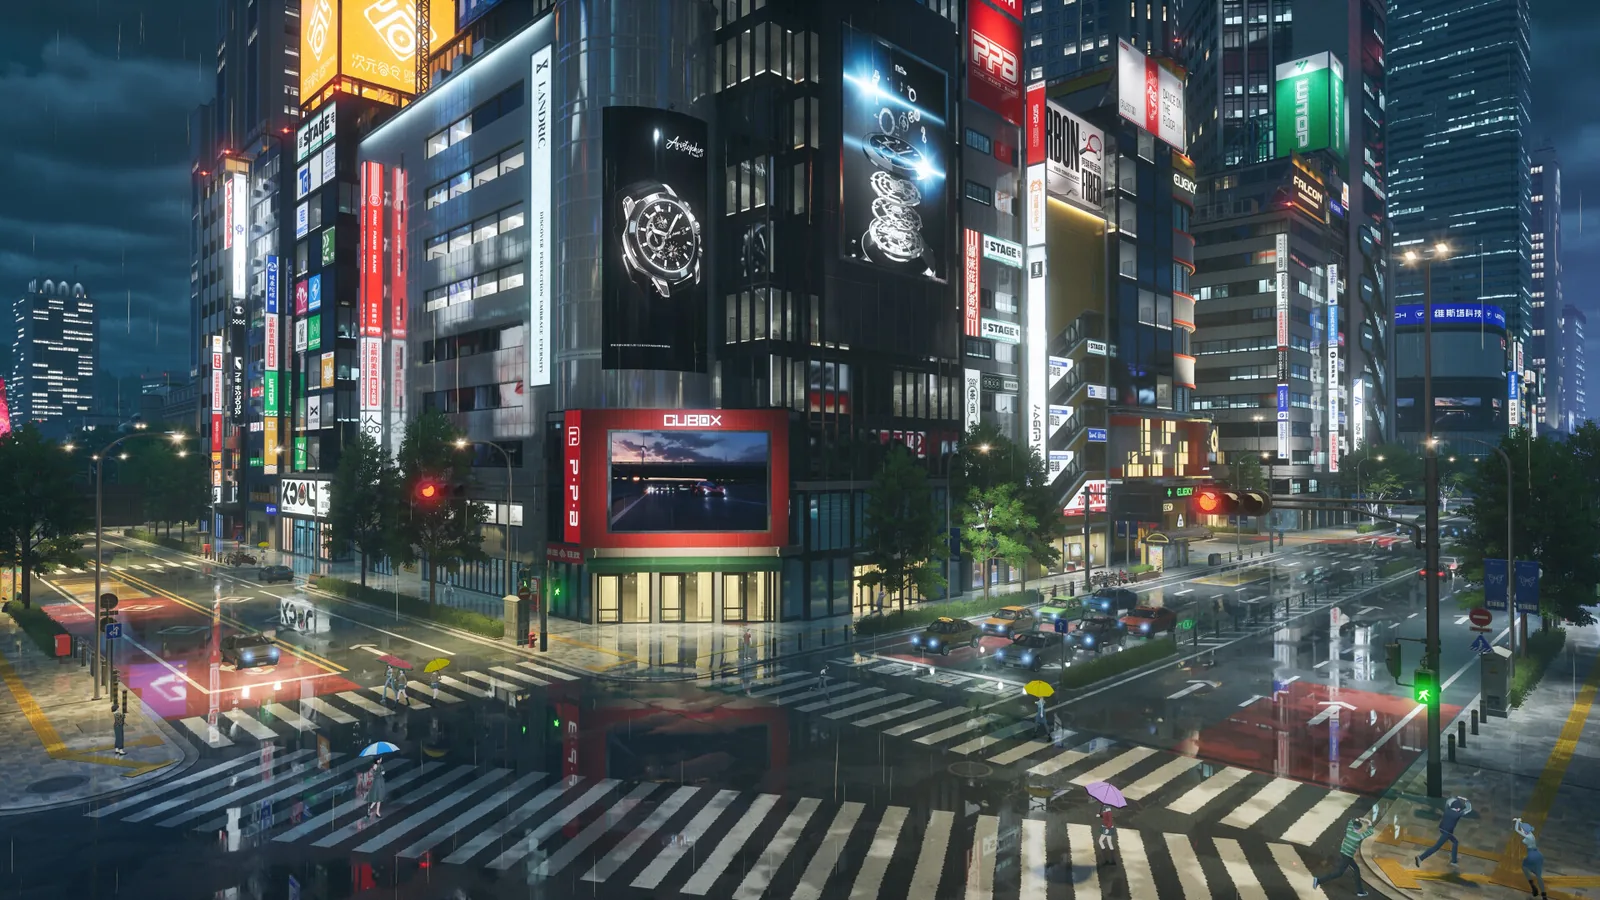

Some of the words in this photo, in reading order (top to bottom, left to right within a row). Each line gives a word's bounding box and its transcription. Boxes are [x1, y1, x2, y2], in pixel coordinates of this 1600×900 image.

[537, 80, 547, 149] LANDRIC
[1081, 168, 1102, 208] FIBER
[1293, 175, 1323, 204] FALCON
[990, 241, 1017, 258] STAGE
[1434, 308, 1482, 318] 维斯塔科技
[987, 323, 1015, 336] STAGE
[1090, 342, 1104, 351] STAGE
